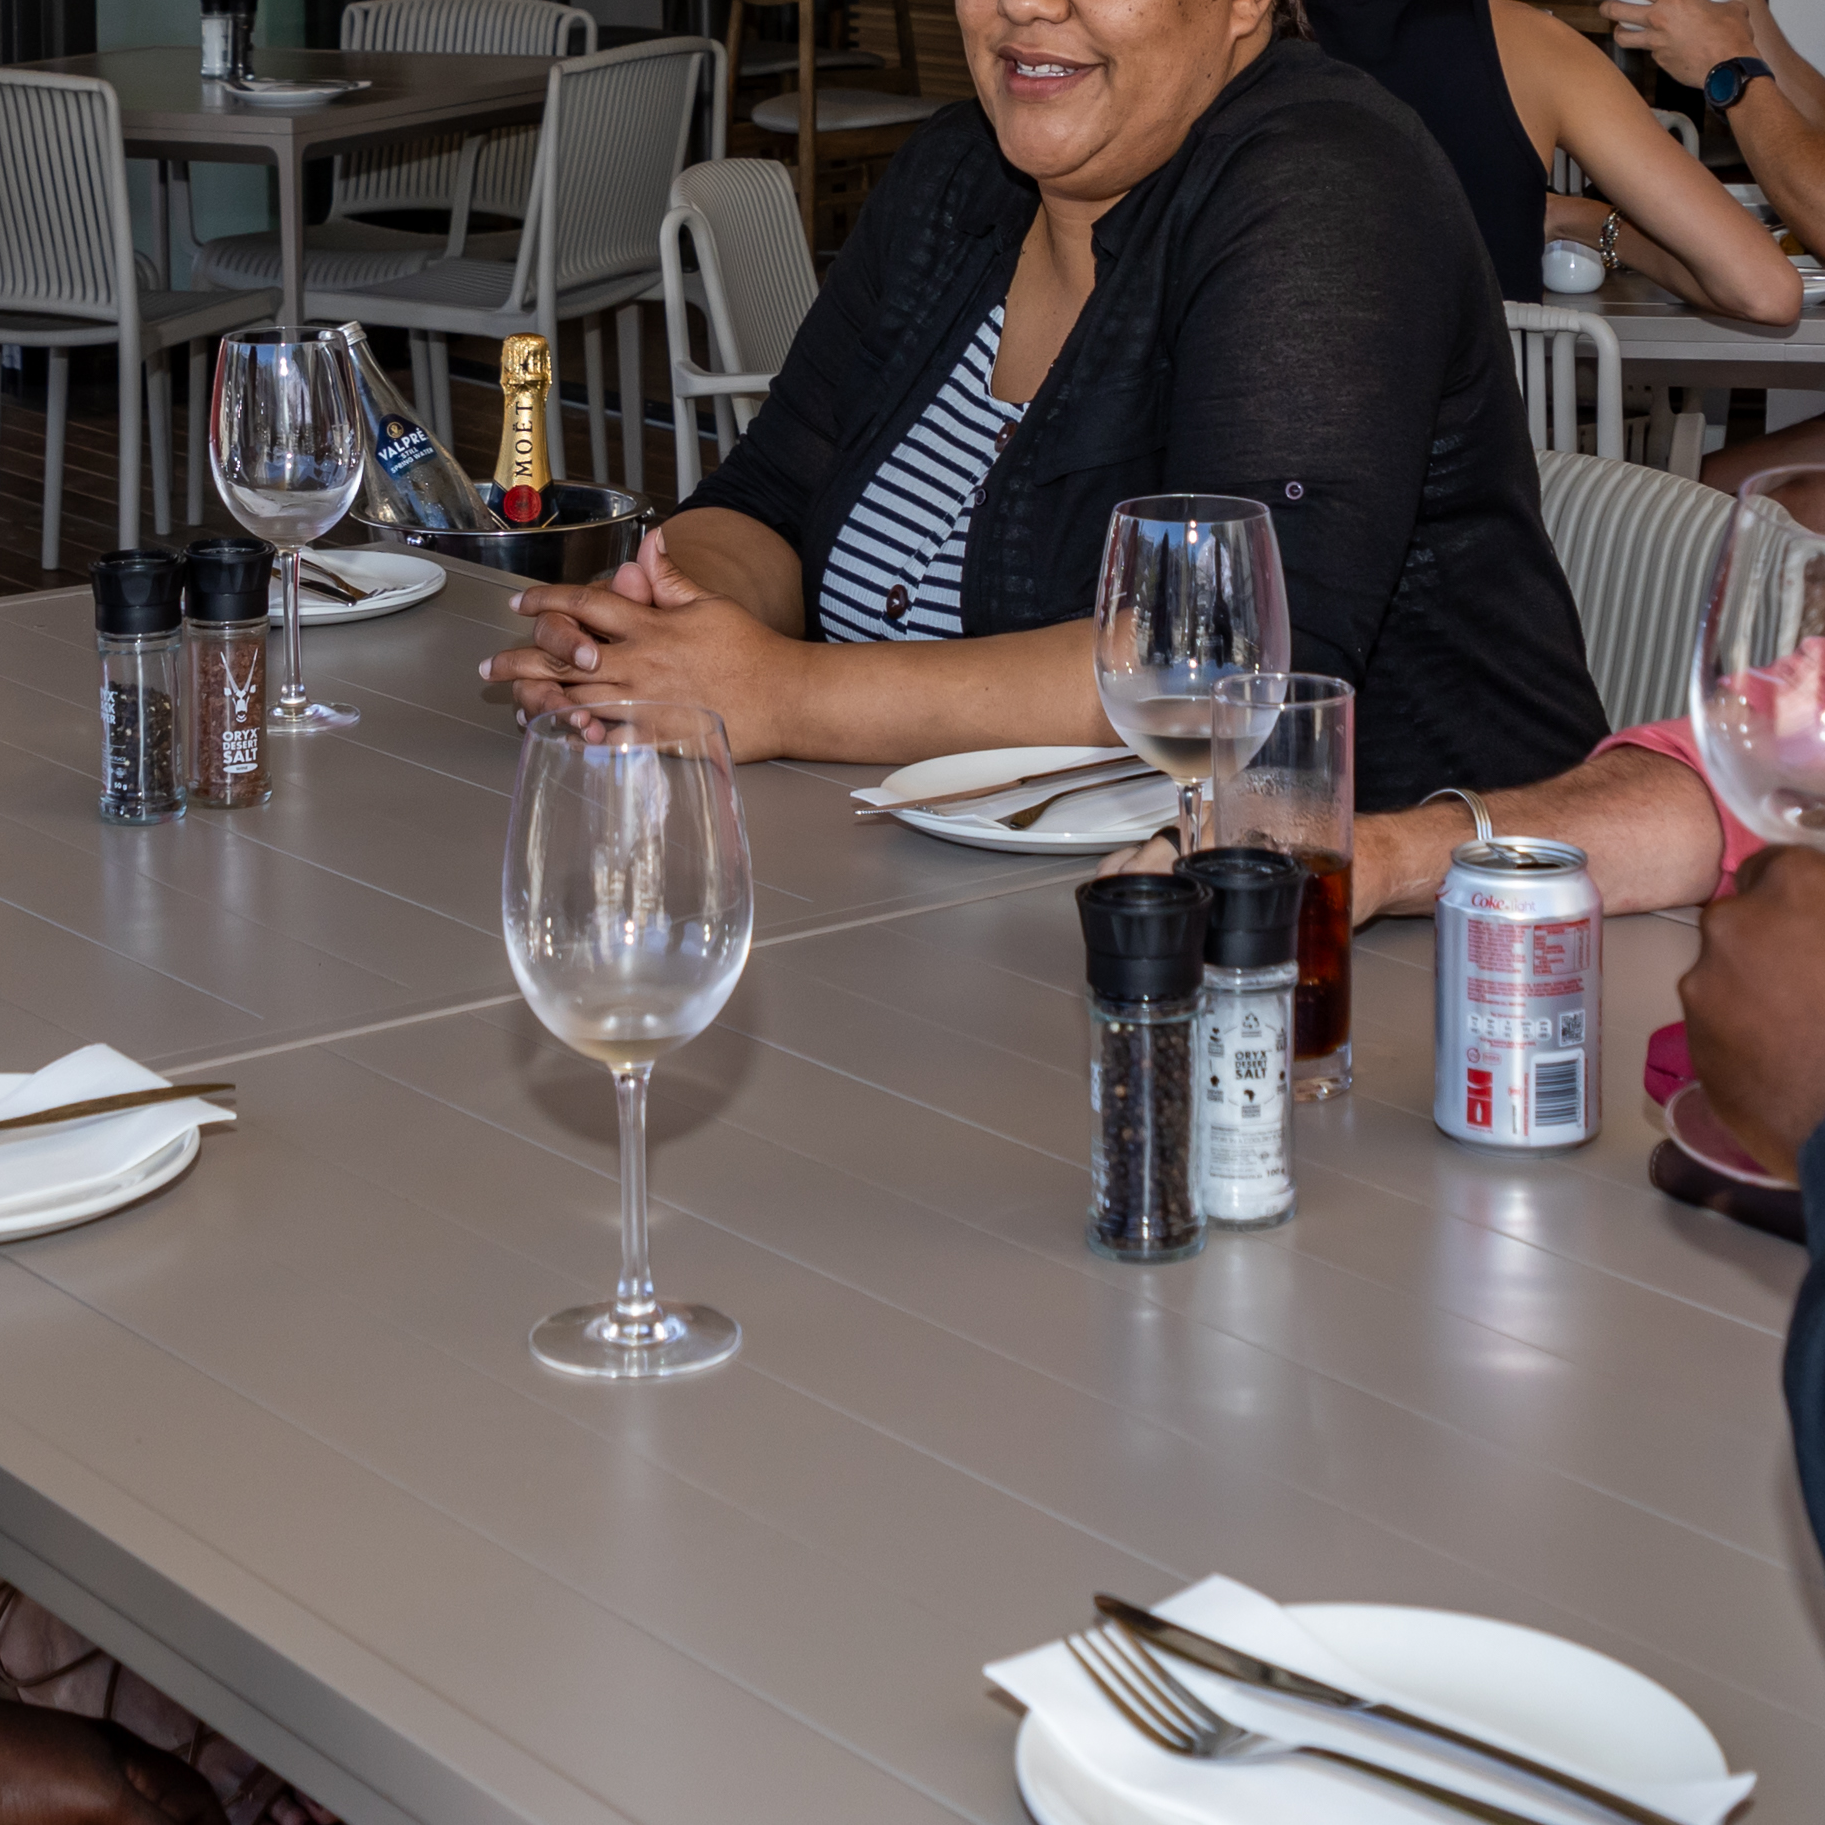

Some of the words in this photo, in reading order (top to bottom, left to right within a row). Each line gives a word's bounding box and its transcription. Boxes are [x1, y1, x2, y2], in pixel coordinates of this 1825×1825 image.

[377, 427, 428, 461] VALPRÉ
[512, 401, 533, 478] MOËT
[414, 447, 434, 460] WATER
[222, 728, 258, 742] ORYX
[222, 738, 258, 751] DESERT
[222, 747, 258, 764] SALT
[1471, 891, 1505, 911] Coke
[1235, 1050, 1268, 1060] ORYX
[1235, 1060, 1268, 1069] DESERT
[1235, 1067, 1268, 1080] SALT
